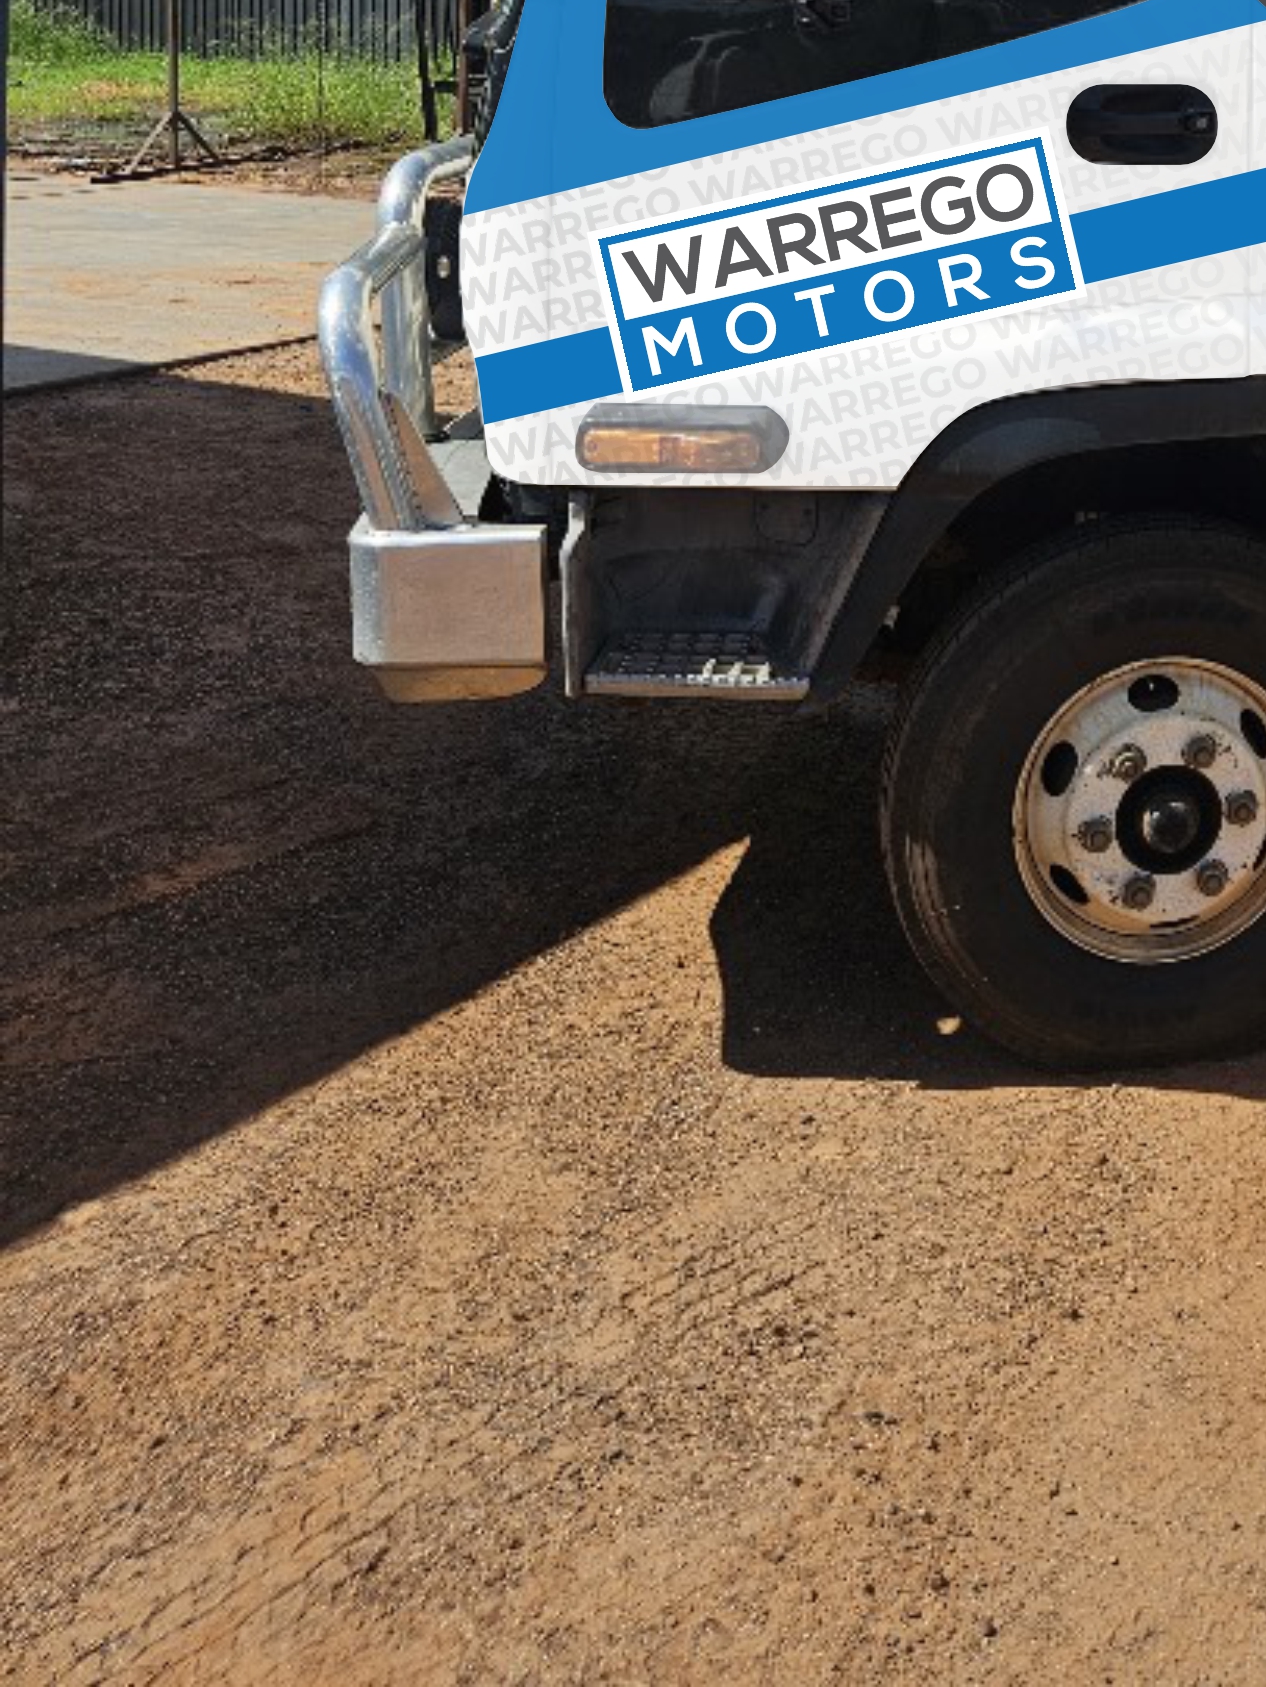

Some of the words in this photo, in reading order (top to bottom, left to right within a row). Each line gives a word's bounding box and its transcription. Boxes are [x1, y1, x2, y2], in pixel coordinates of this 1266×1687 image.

[687, 124, 928, 206] WARREGO
[622, 163, 1034, 303] WARREGO
[641, 236, 1056, 377] MOTORS
[994, 293, 1236, 379] WARREGO
[738, 323, 977, 404] WARREGO
